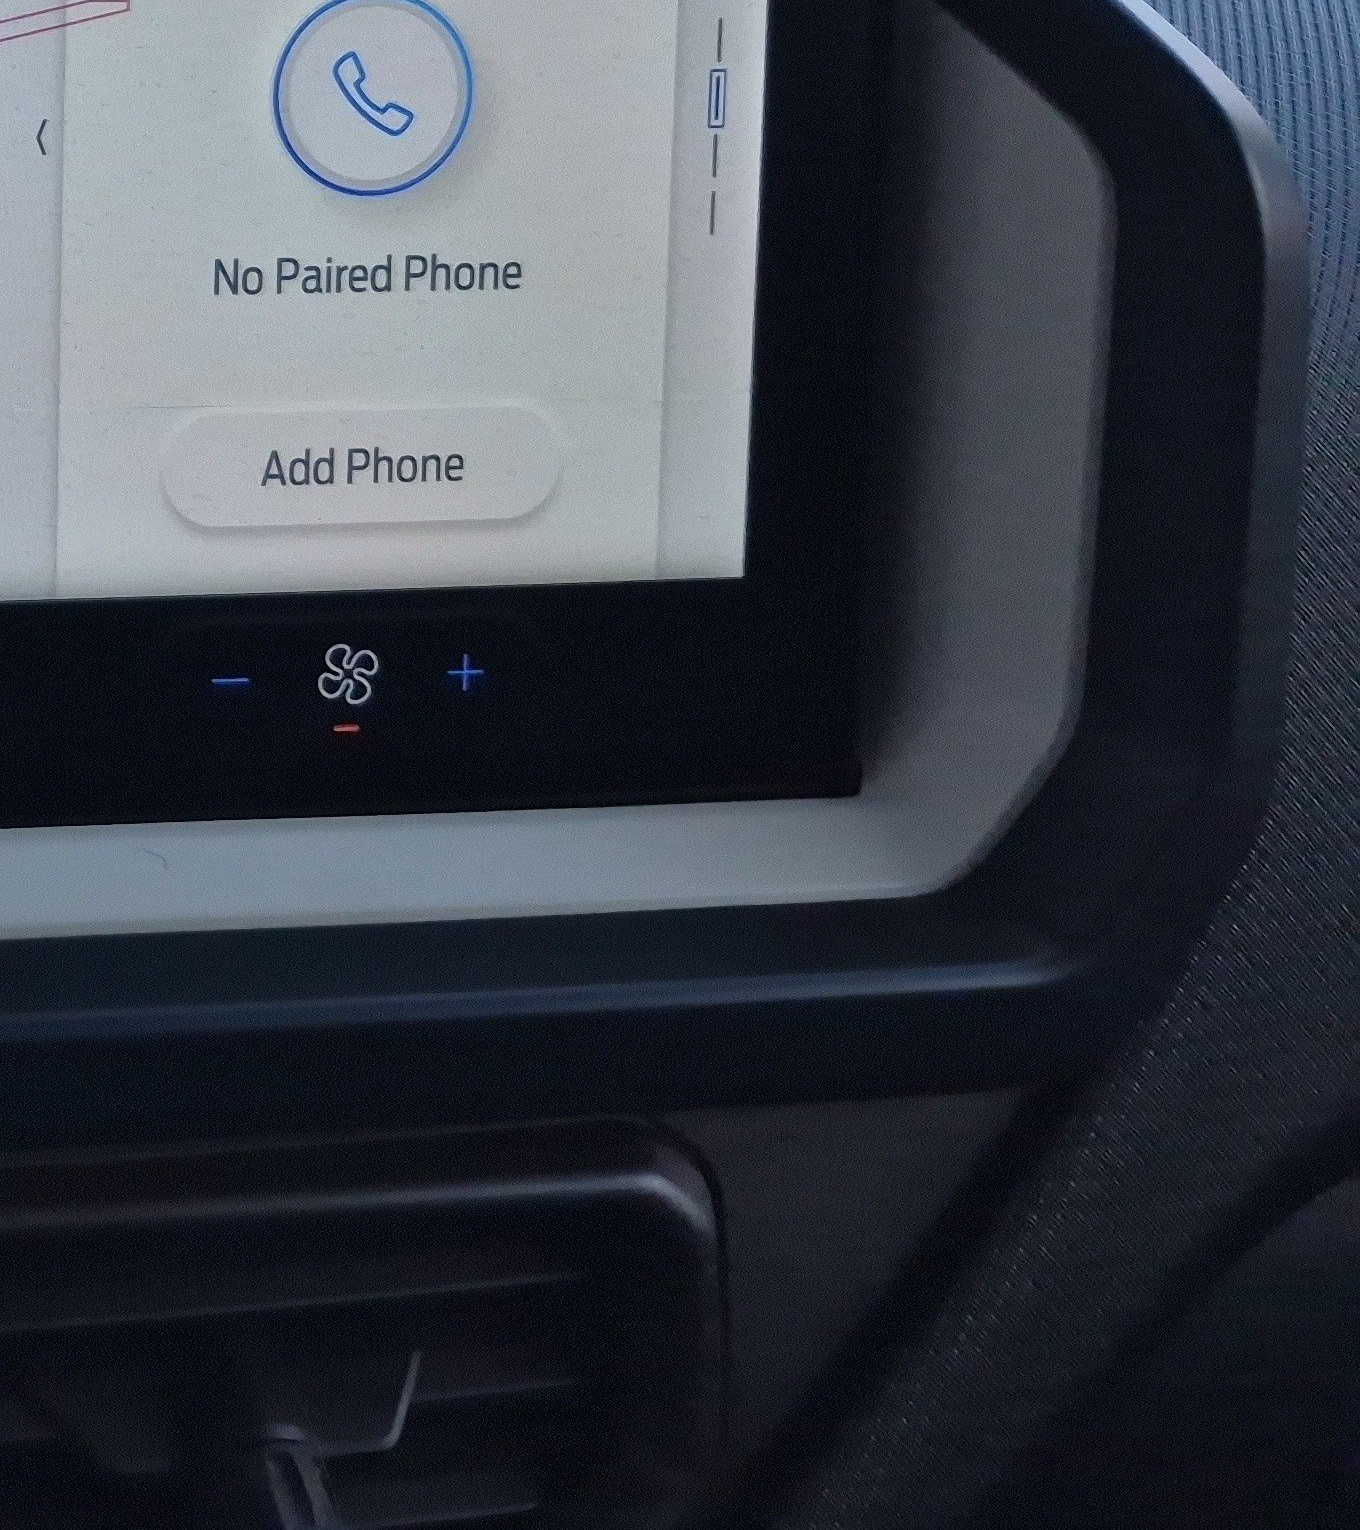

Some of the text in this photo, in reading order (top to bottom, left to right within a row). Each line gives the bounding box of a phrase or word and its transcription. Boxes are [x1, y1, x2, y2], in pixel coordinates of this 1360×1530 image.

[212, 254, 523, 296] No Paired Phone
[261, 447, 465, 487] Add Phone
